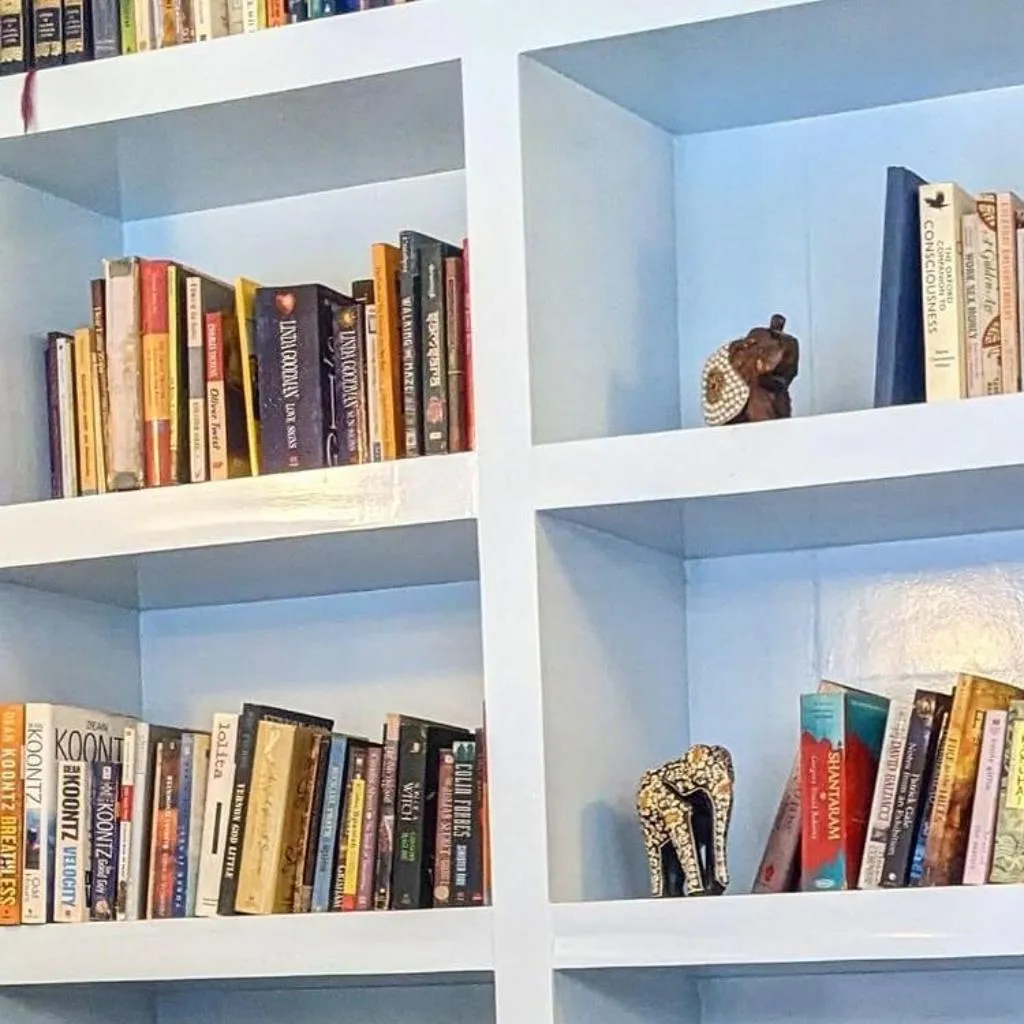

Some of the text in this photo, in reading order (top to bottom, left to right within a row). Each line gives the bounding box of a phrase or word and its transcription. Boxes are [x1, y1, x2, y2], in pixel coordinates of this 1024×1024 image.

[924, 220, 937, 334] CONSCIOUSNESS
[945, 266, 953, 304] OXFORD
[965, 253, 975, 280] WORK
[983, 249, 996, 291] Golden
[402, 297, 414, 346] WALKING
[939, 300, 946, 311] TO
[967, 307, 977, 339] MONEY
[280, 320, 297, 349] LINDA
[281, 351, 300, 398] GOODMAN
[340, 331, 358, 408] LINDA GOODMAN
[209, 388, 221, 450] Oliver Twist
[26, 729, 43, 805] KOONTZ
[213, 723, 230, 779] lolita
[887, 740, 902, 772] DAVID
[905, 743, 917, 770] Notes
[947, 738, 958, 761] FIRE
[1, 748, 17, 810] KOONTZ
[453, 763, 474, 838] COLIN FORBES
[828, 752, 841, 839] SHANTARAM
[899, 772, 910, 794] from
[903, 774, 920, 828] Patrick Gale
[401, 782, 413, 821] WITCH
[898, 796, 906, 808] an
[62, 775, 81, 907] KOONTZ VELOCITY
[96, 802, 114, 858] KOONTZ
[231, 824, 244, 844] GOD
[0, 816, 17, 906] BREATHLESS
[224, 846, 242, 879] LITTLE
